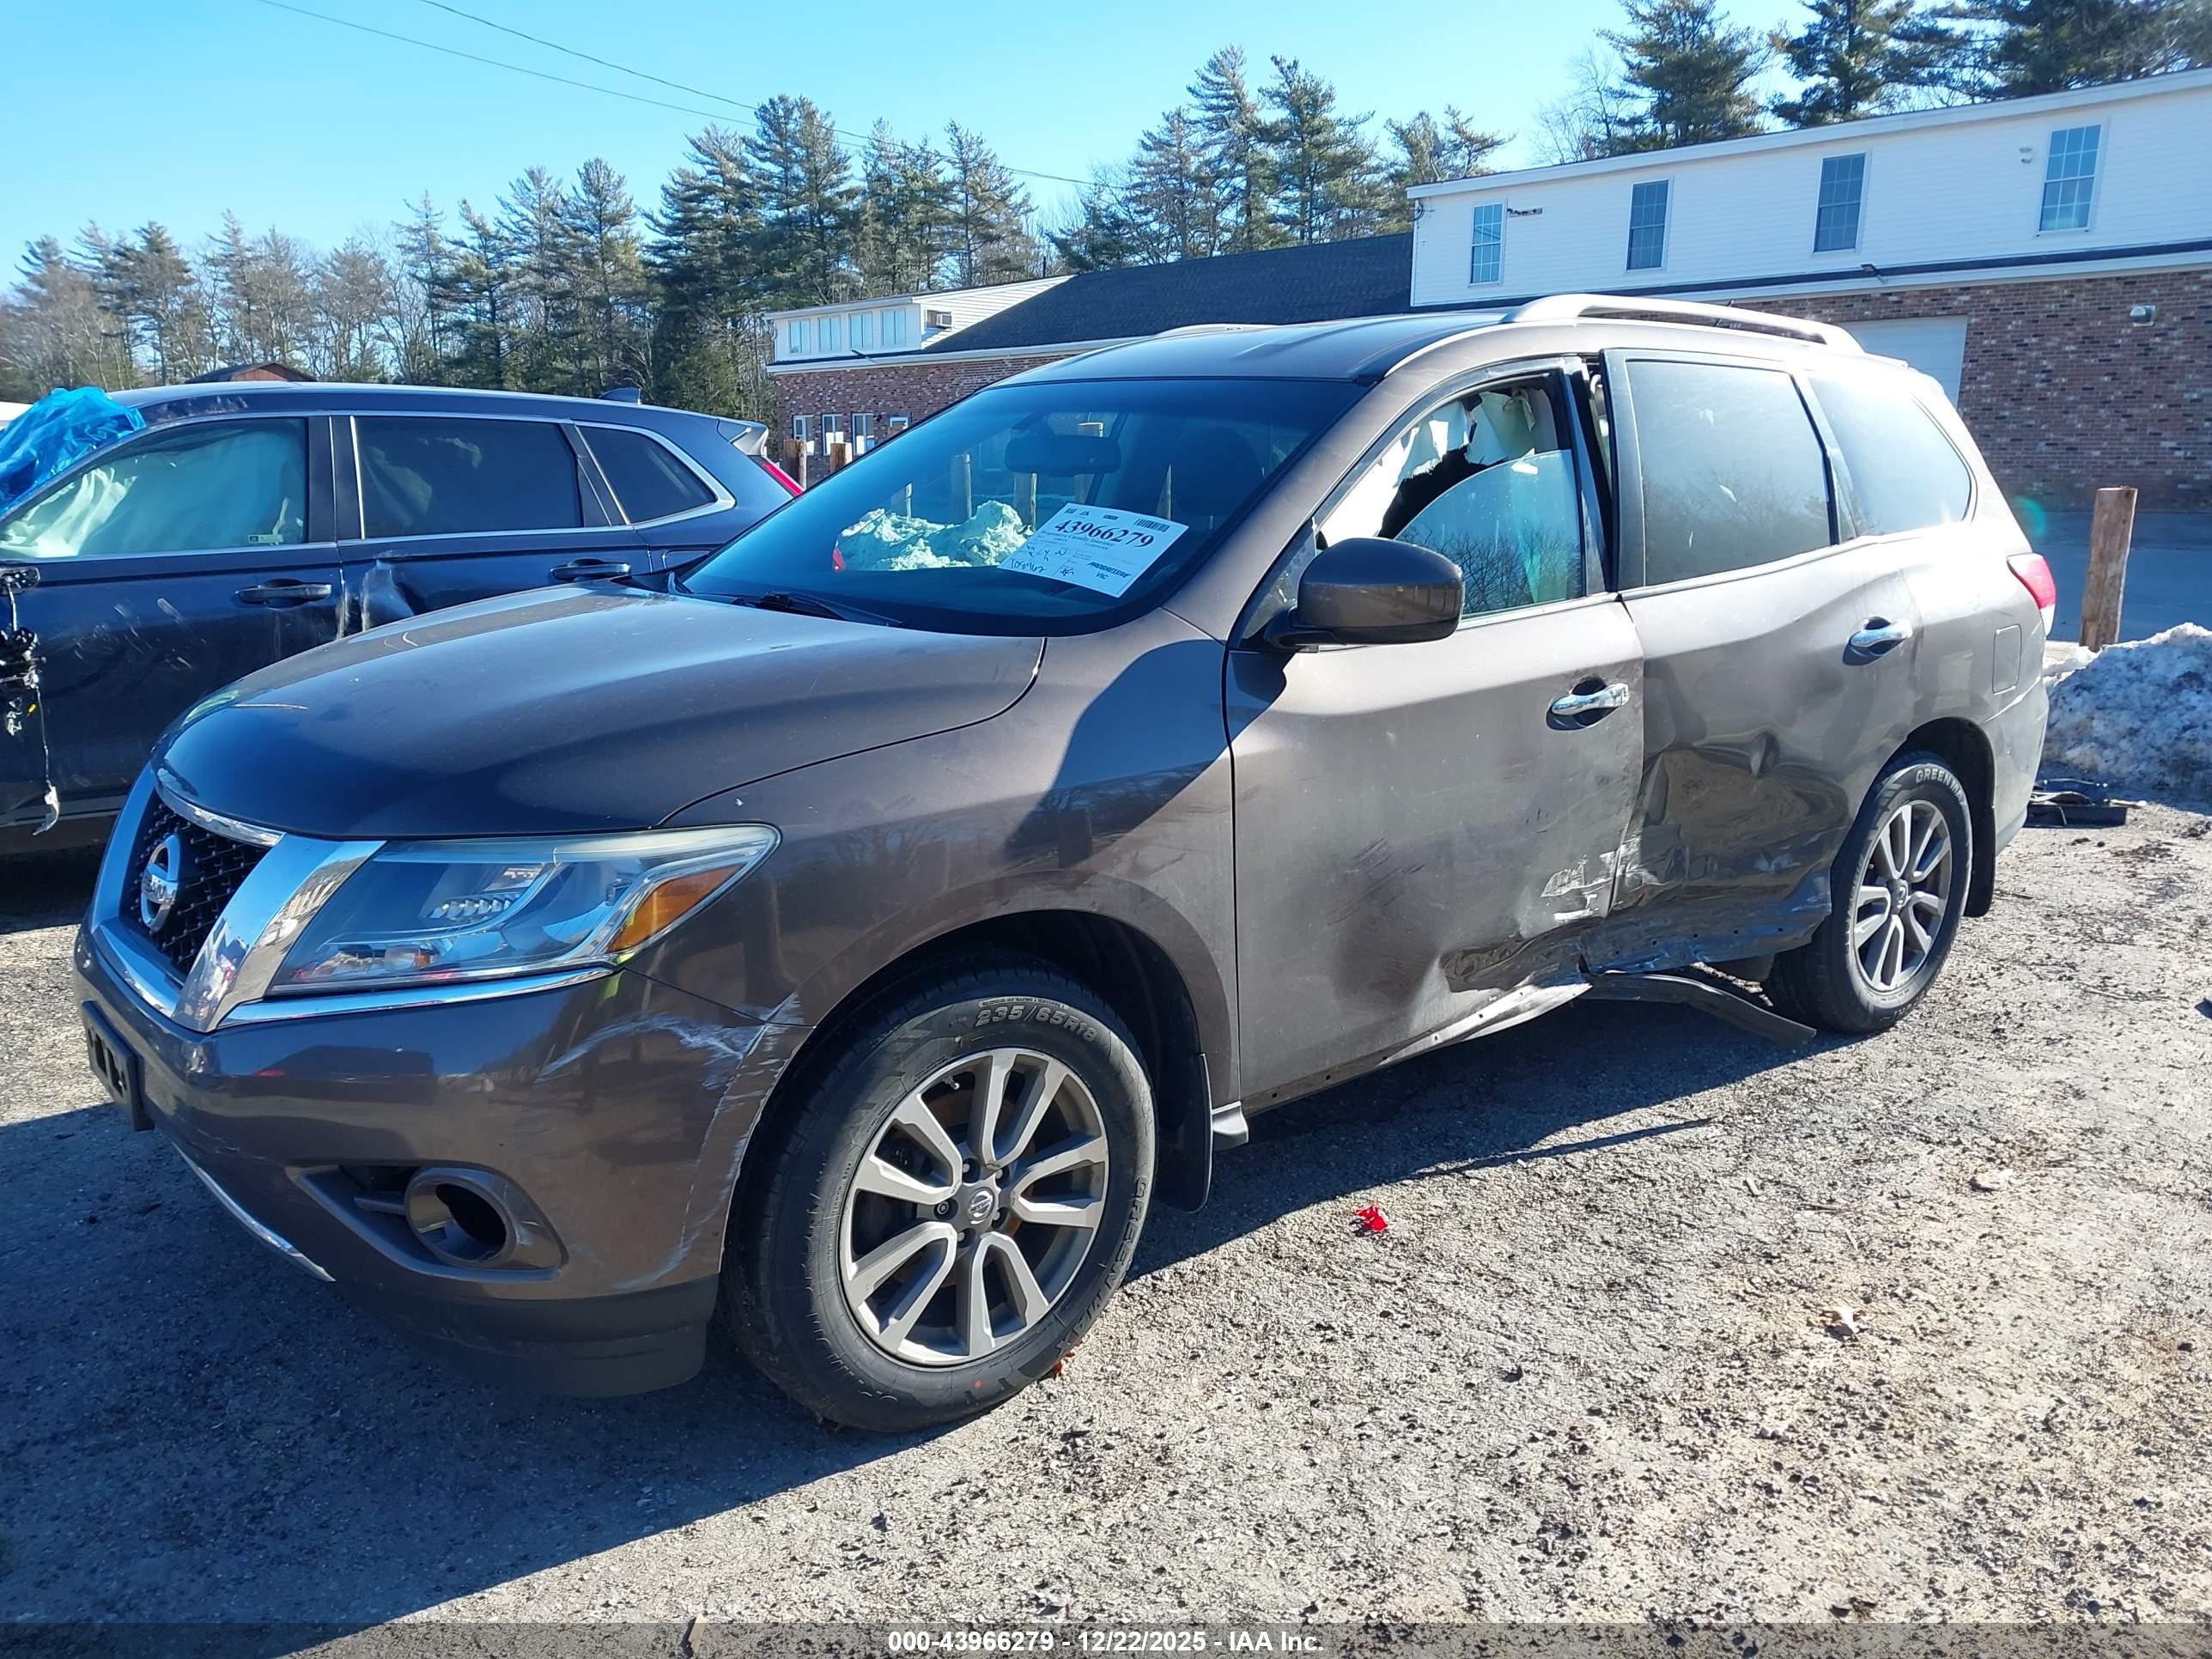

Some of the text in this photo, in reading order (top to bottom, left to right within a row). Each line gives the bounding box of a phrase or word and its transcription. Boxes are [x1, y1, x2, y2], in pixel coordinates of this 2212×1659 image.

[1054, 519, 1155, 549] 43966279
[1086, 562, 1132, 579] PROGRESSIVE
[975, 1005, 1098, 1042] 235/65R18
